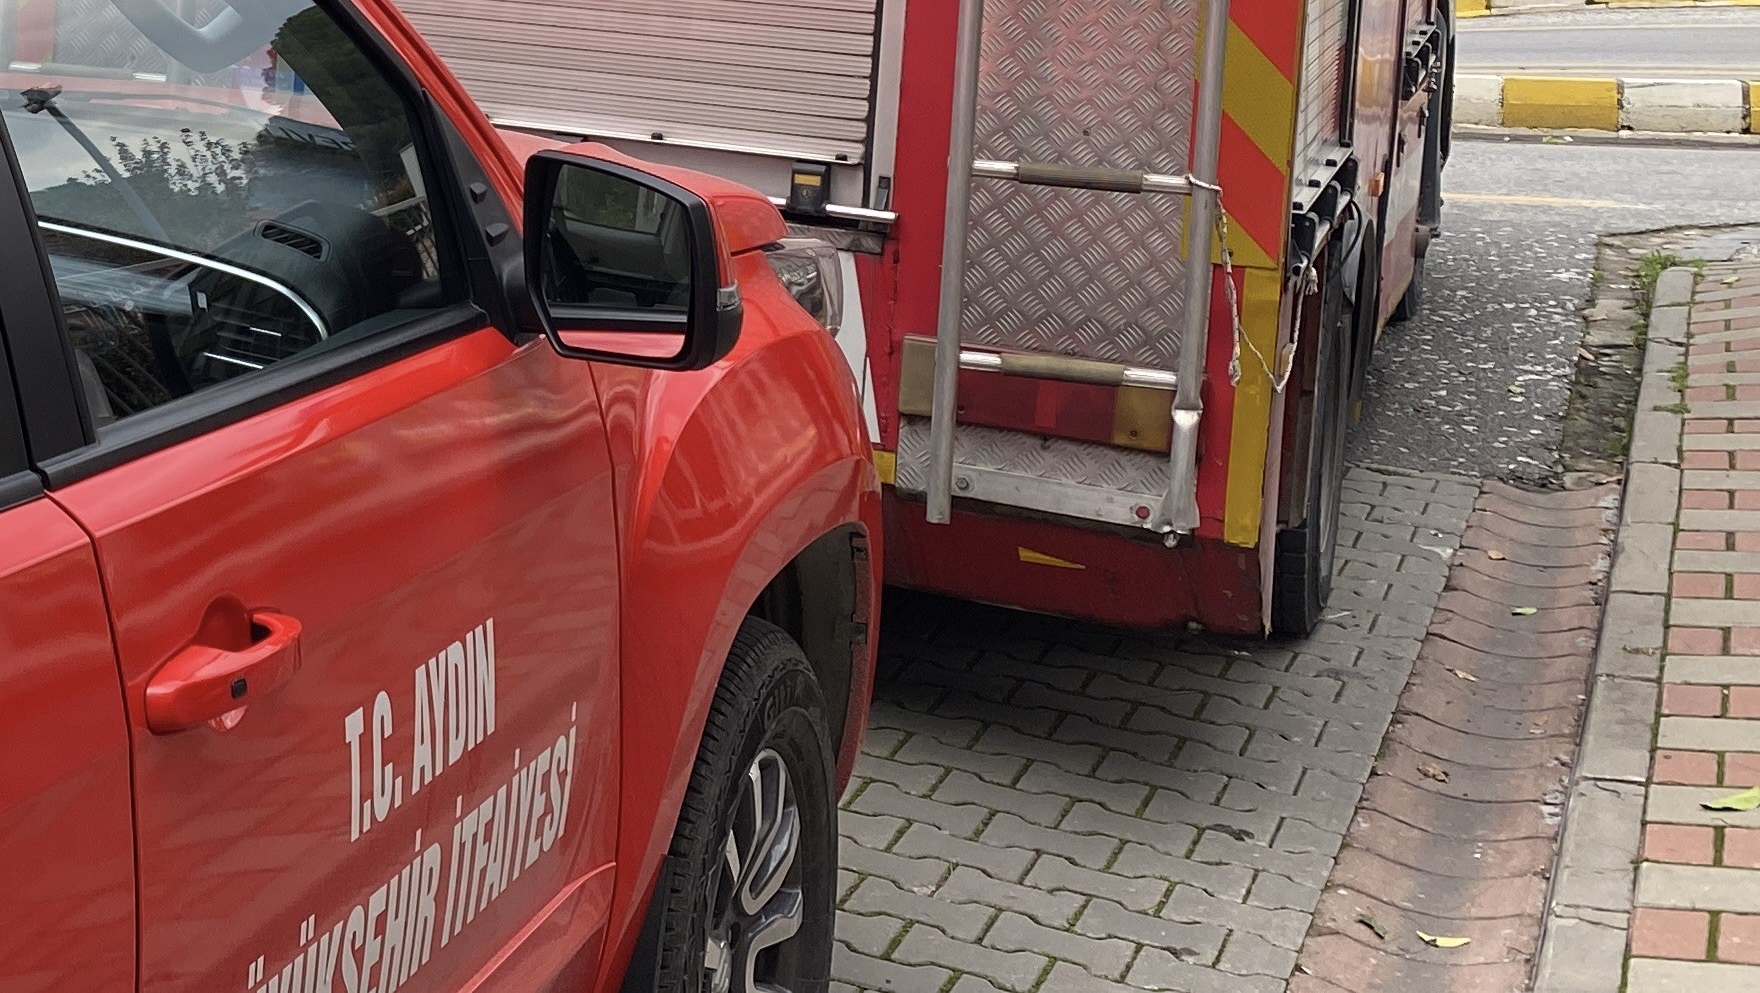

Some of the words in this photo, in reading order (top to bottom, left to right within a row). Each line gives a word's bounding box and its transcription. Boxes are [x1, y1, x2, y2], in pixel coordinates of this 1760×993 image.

[344, 690, 403, 843] T.C.
[411, 617, 496, 796] AYDIN
[441, 701, 577, 949] İTFAİYESİ
